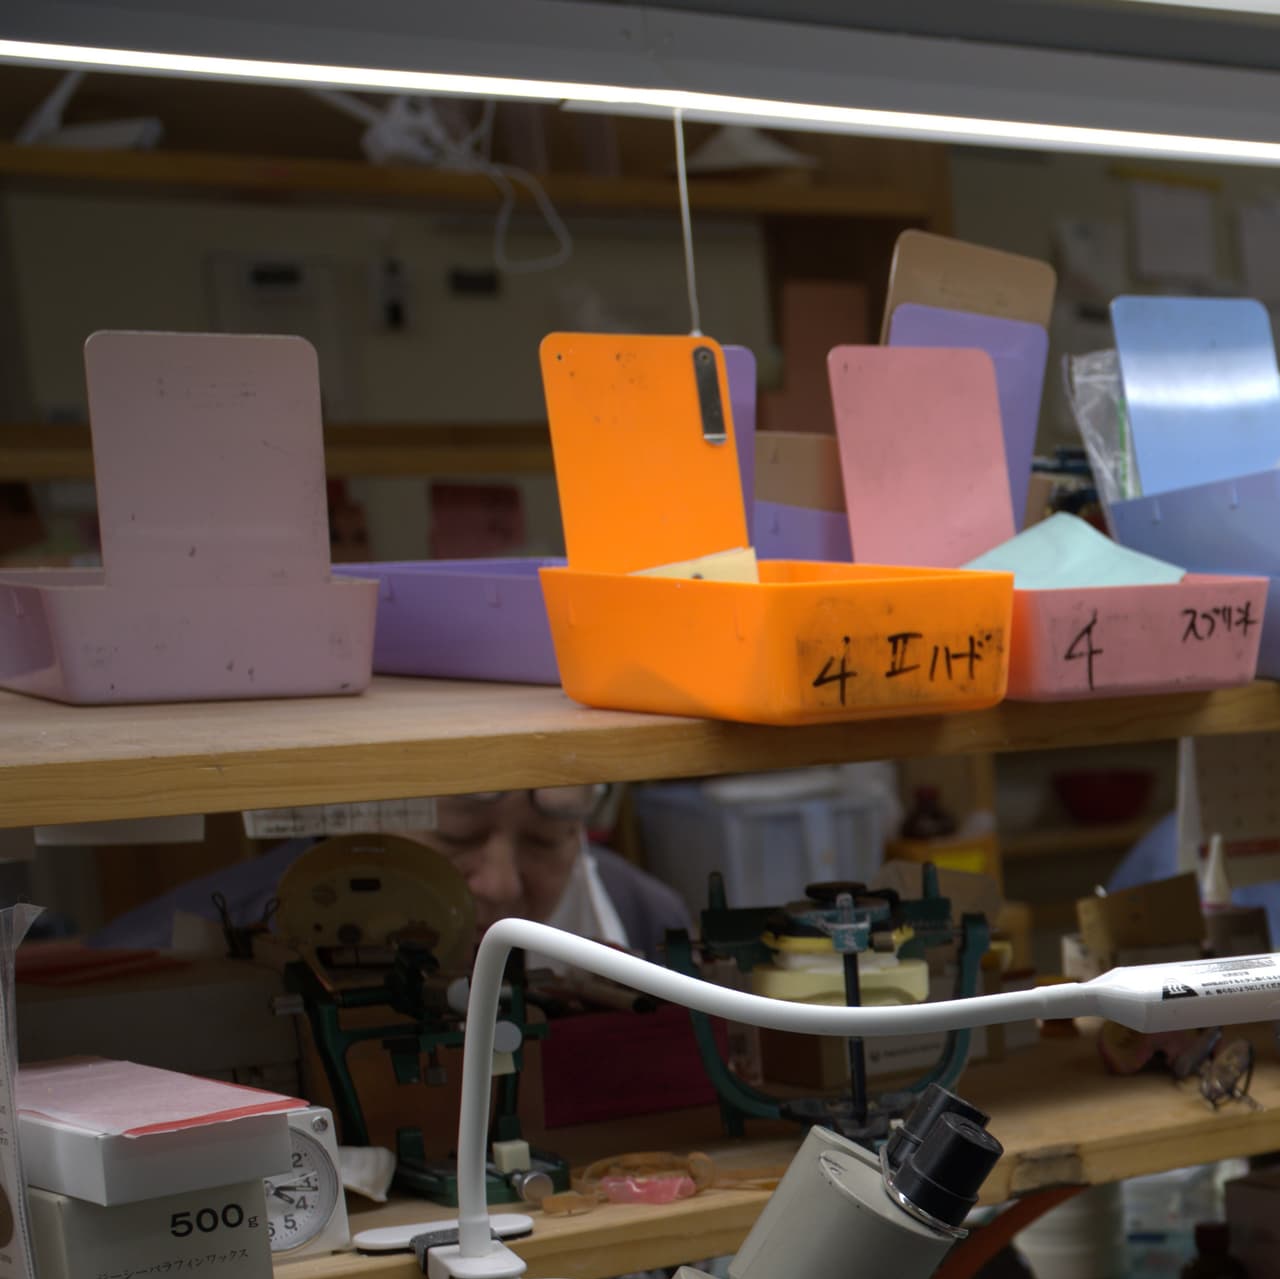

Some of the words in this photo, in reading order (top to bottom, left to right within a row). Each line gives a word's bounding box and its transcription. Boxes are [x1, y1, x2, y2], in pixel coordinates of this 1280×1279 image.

[1064, 608, 1103, 691] 4
[812, 636, 858, 706] 4
[291, 1152, 304, 1169] 2
[295, 1196, 308, 1210] 4
[284, 1214, 297, 1230] 5
